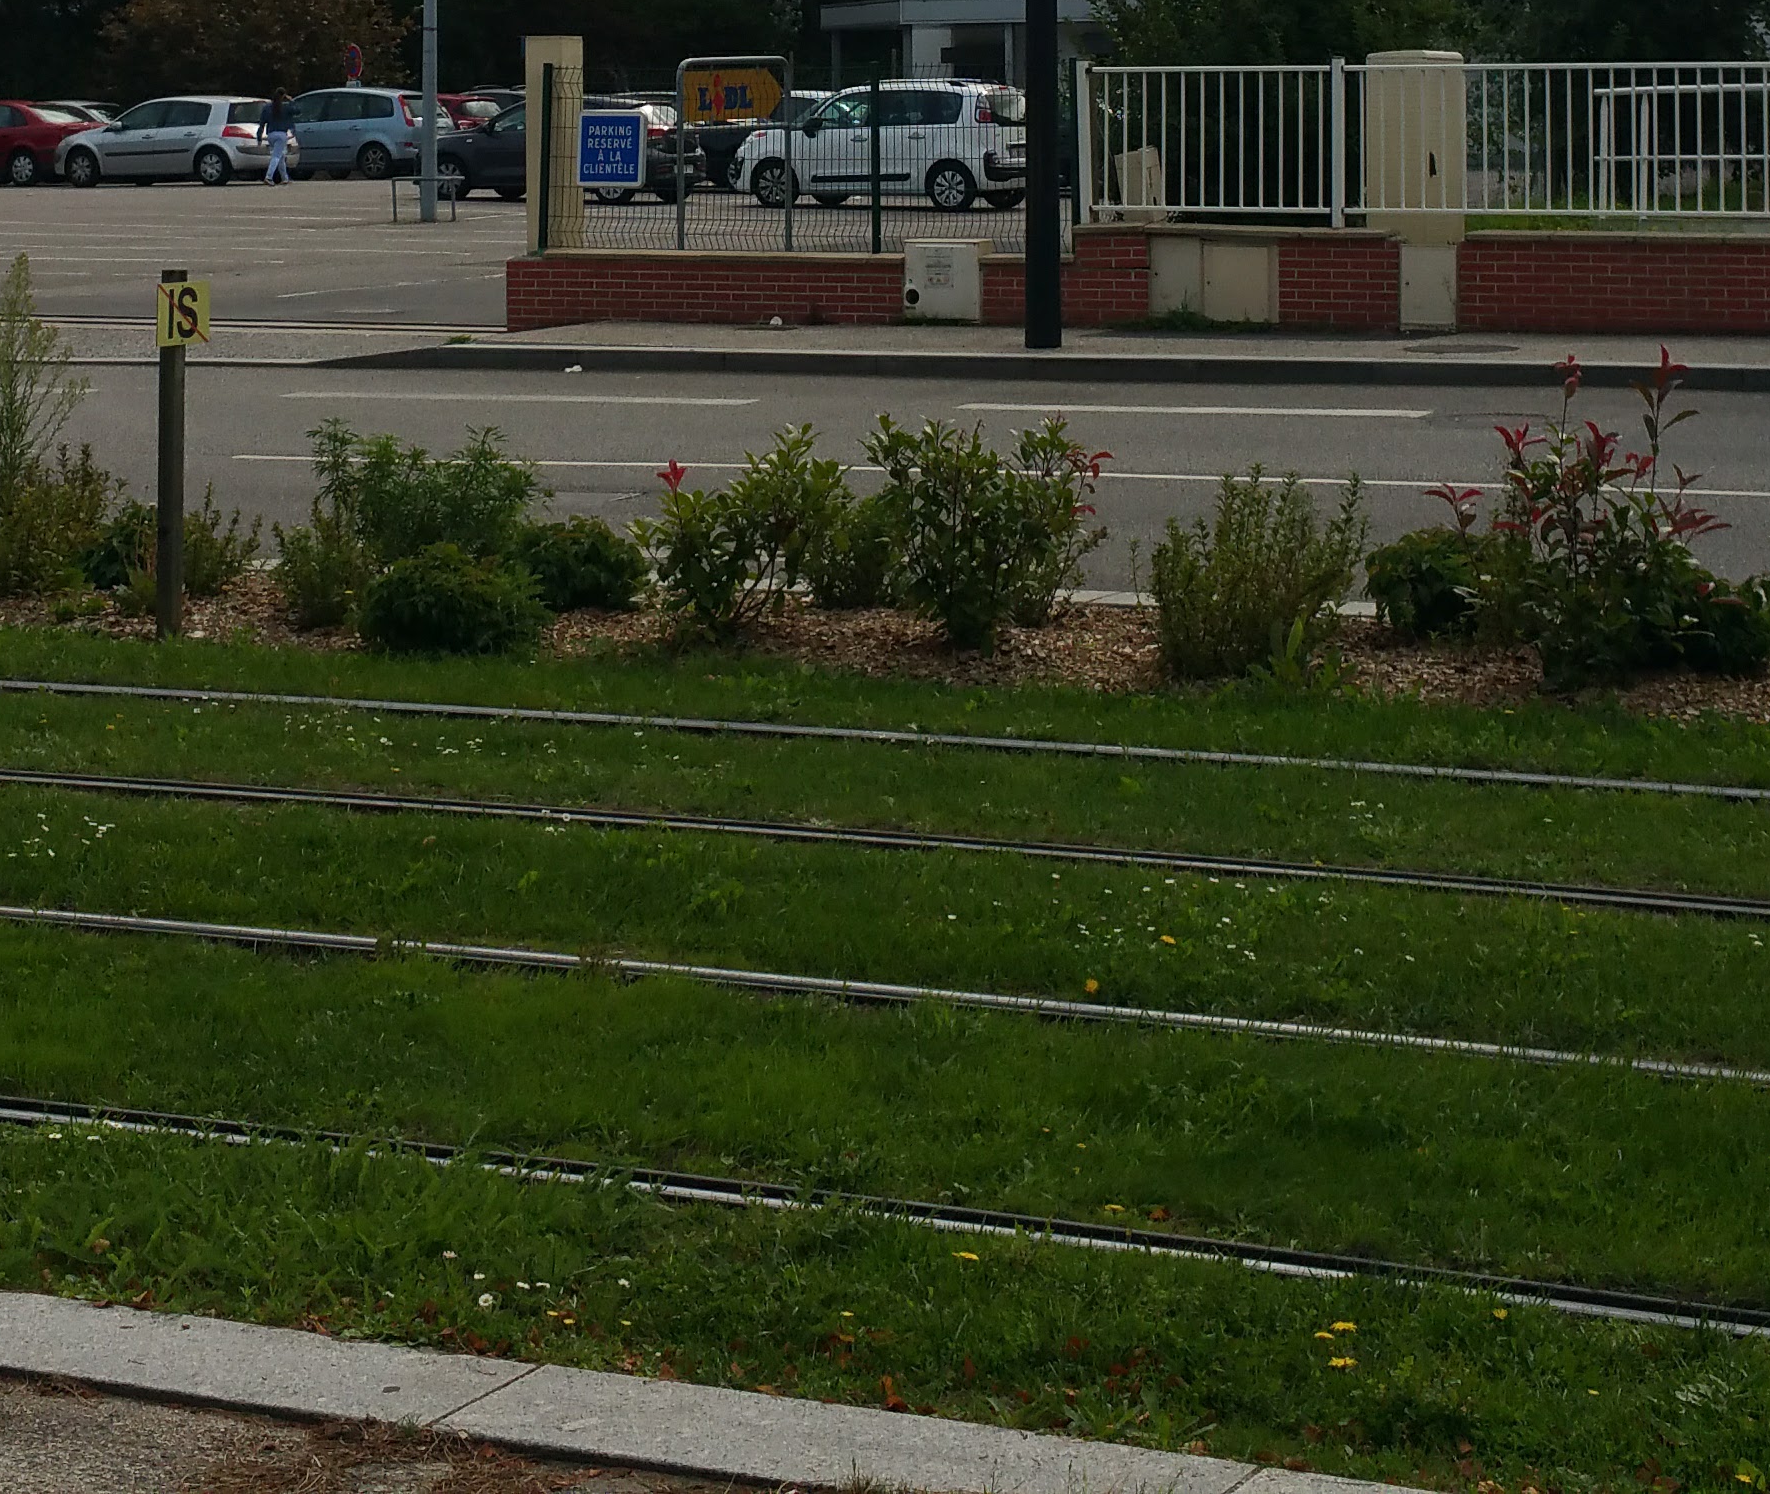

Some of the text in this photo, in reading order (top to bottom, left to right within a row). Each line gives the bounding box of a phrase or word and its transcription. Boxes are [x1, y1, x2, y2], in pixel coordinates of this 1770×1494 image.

[588, 125, 632, 136] PARKING
[610, 151, 621, 161] LA
[167, 286, 199, 340] IS
